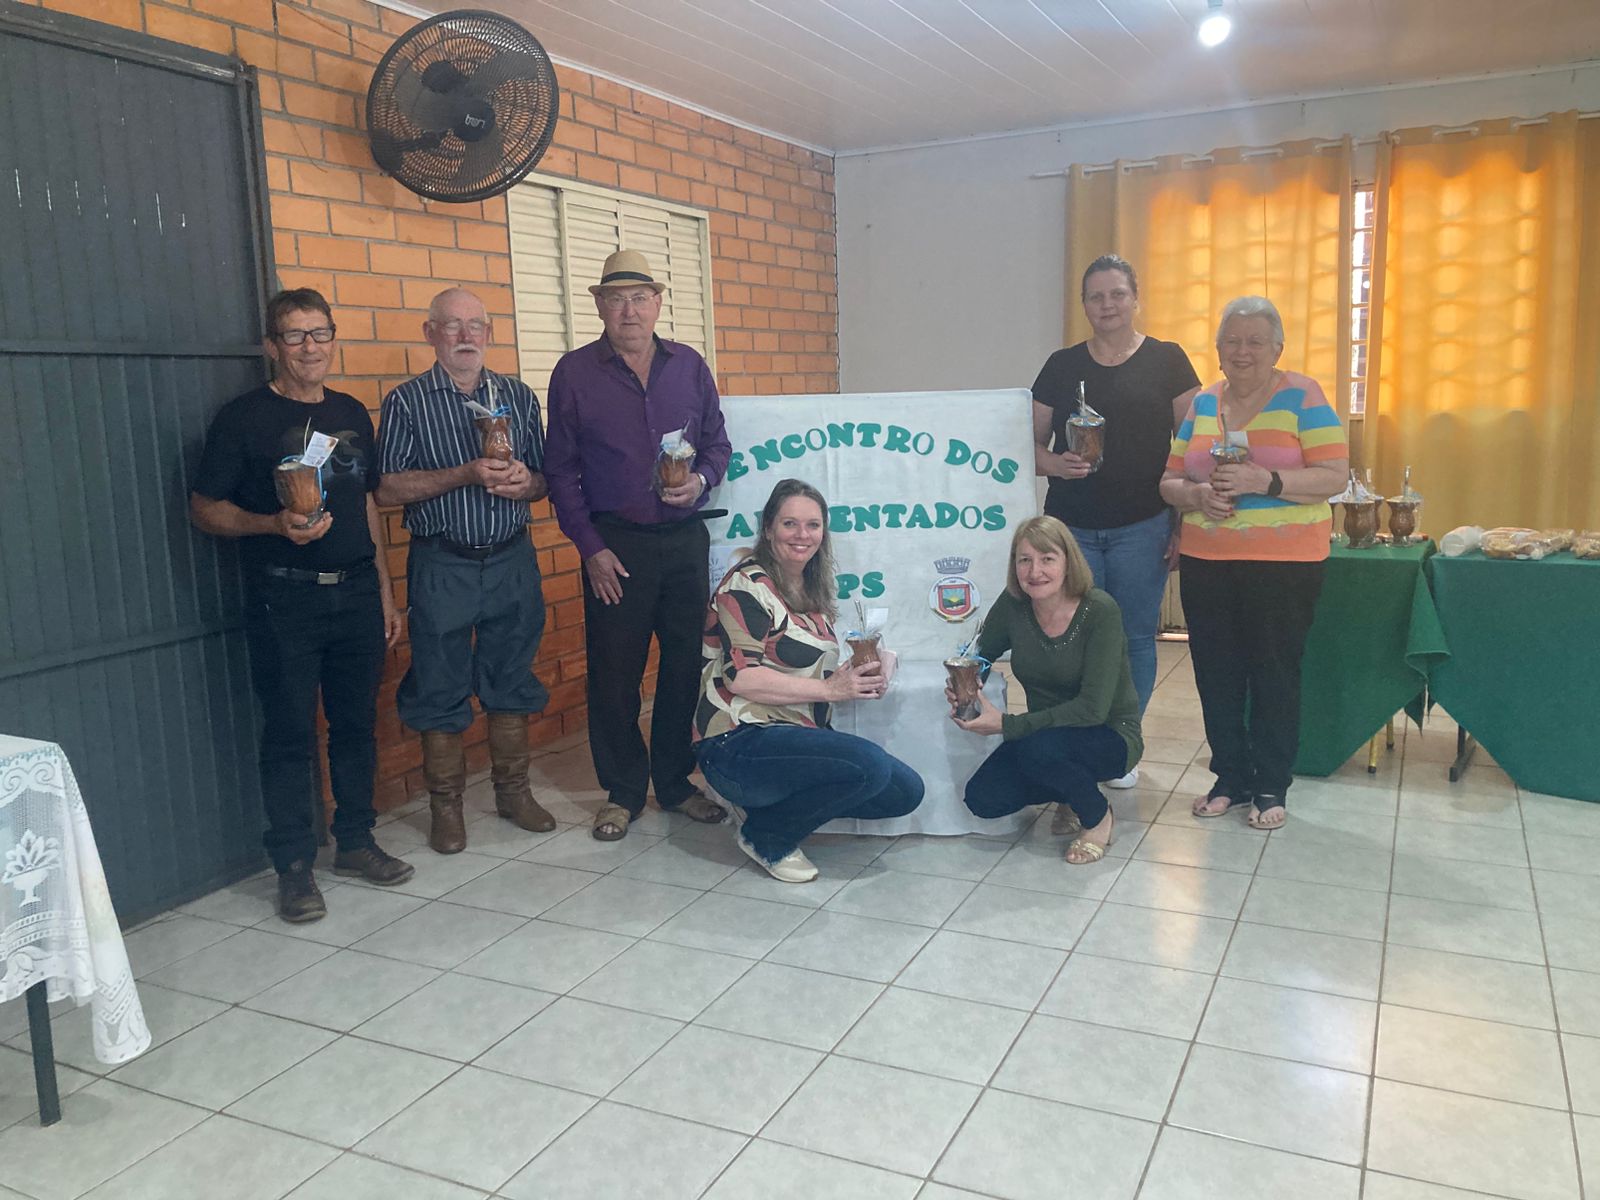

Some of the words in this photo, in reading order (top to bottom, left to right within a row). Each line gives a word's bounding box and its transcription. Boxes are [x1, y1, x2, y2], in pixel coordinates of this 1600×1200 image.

[727, 422, 935, 481] ENCONTRO
[944, 439, 1019, 483] DOS
[726, 502, 1007, 539] AENTADOS
